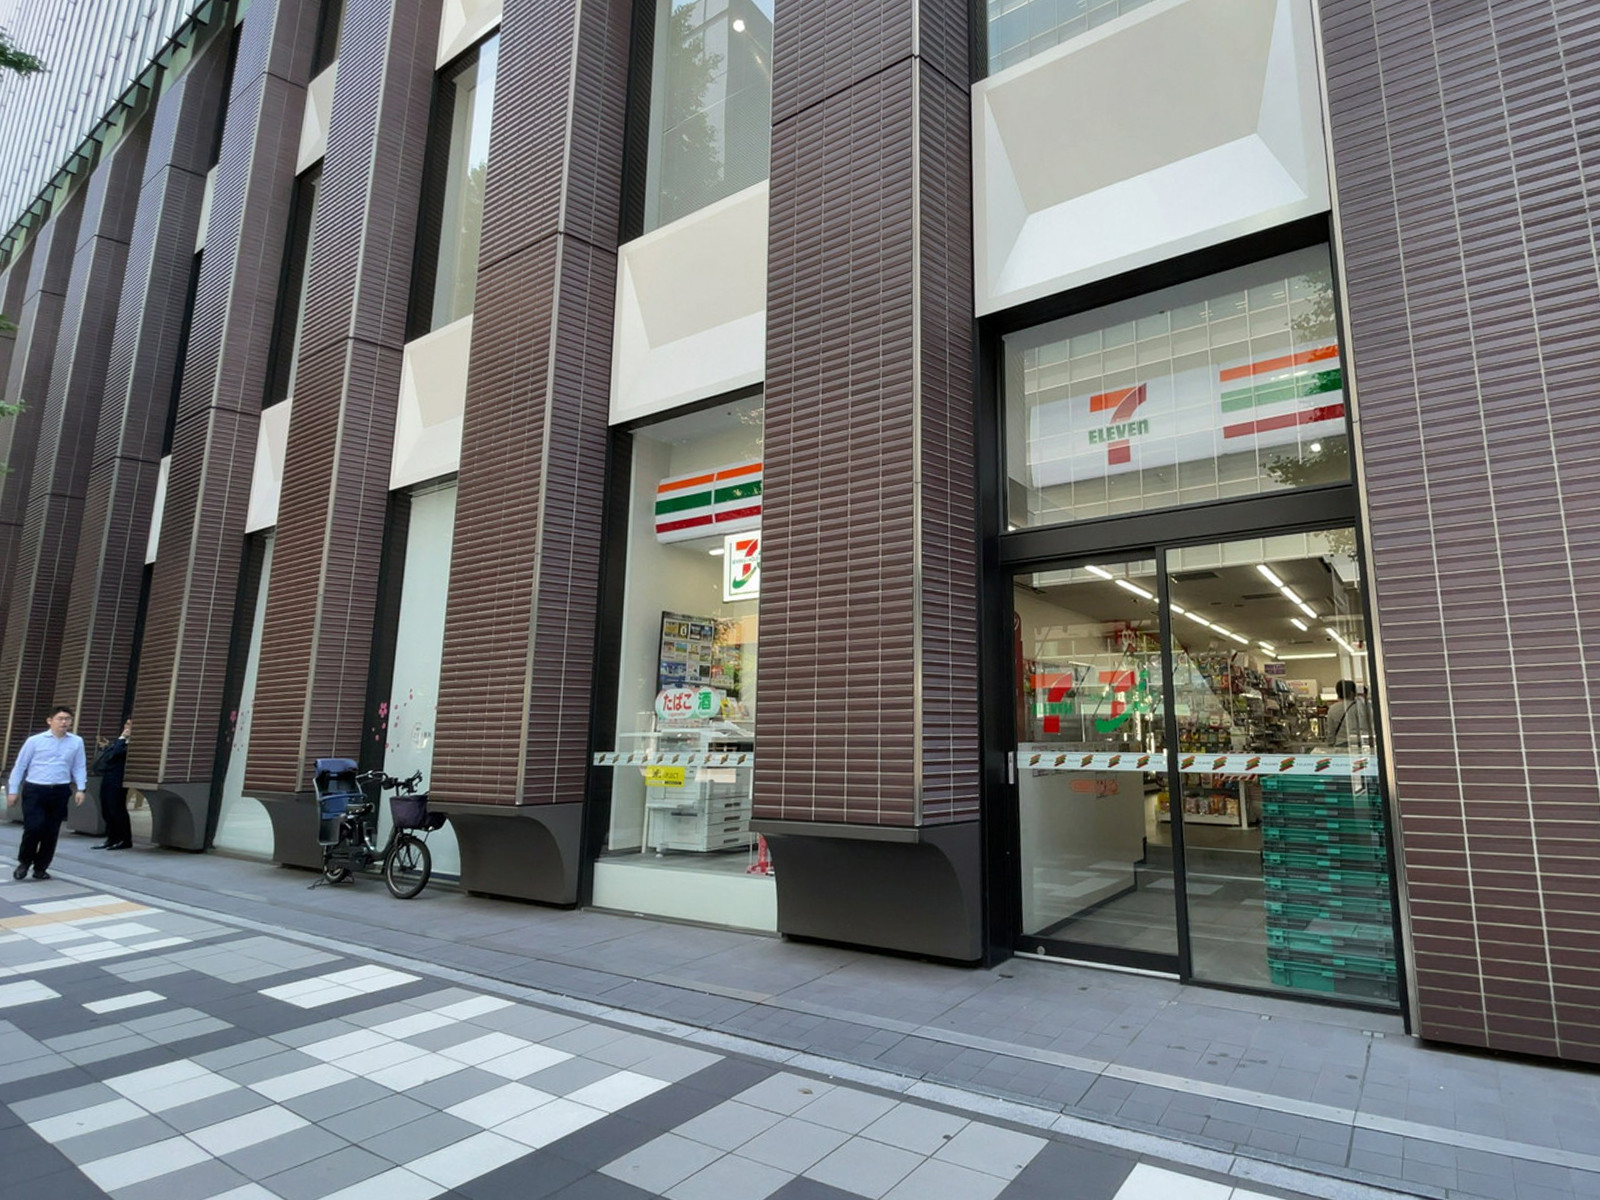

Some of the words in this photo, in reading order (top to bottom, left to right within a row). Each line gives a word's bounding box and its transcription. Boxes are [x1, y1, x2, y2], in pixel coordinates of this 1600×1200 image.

[663, 692, 692, 711] たばこ
[698, 691, 712, 710] 酒
